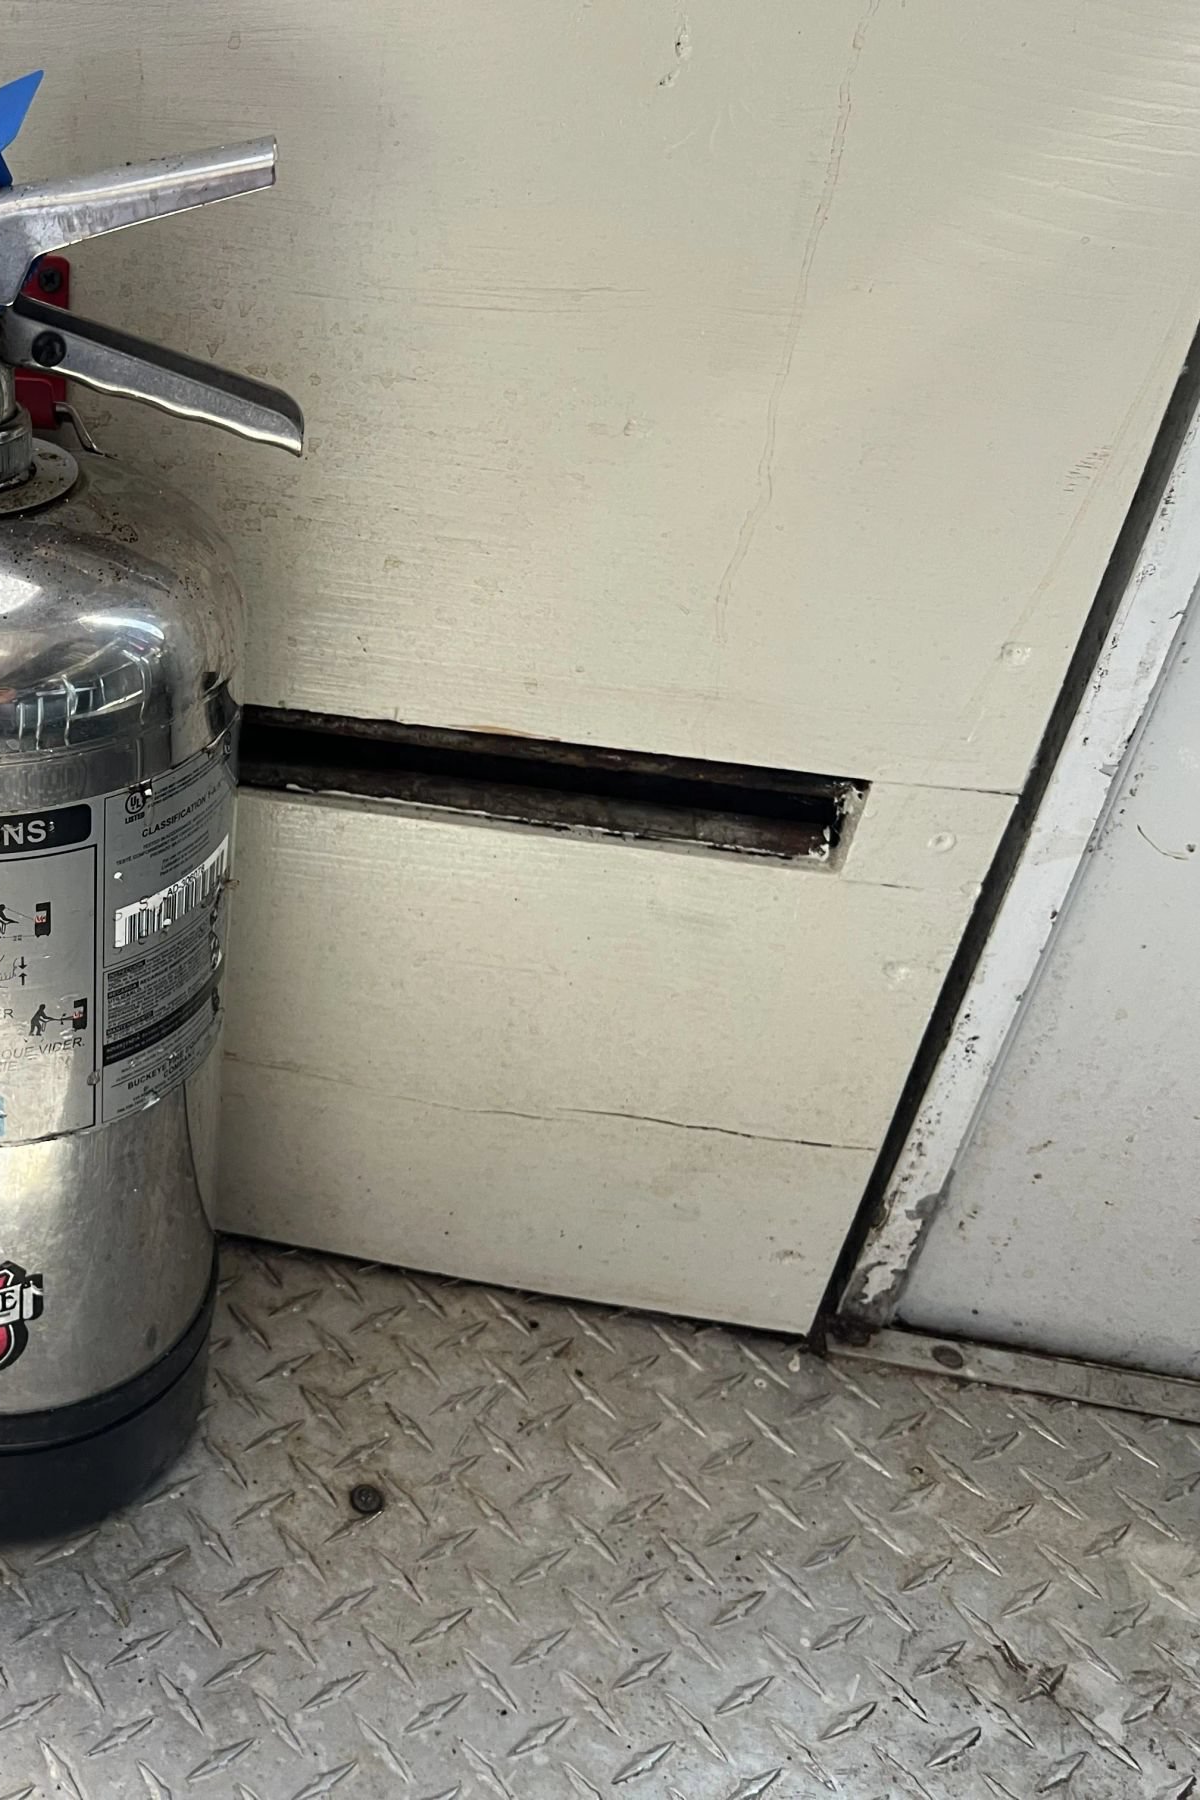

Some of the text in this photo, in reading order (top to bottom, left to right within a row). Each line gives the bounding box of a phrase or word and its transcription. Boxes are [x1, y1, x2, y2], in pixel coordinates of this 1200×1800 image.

[130, 795, 142, 810] UL
[124, 811, 145, 824] LISTED
[142, 796, 207, 838] CLASSIFICATION
[1, 1046, 38, 1060] QUE
[39, 1037, 85, 1054] VIDER.
[128, 1064, 167, 1090] BUCKEYE
